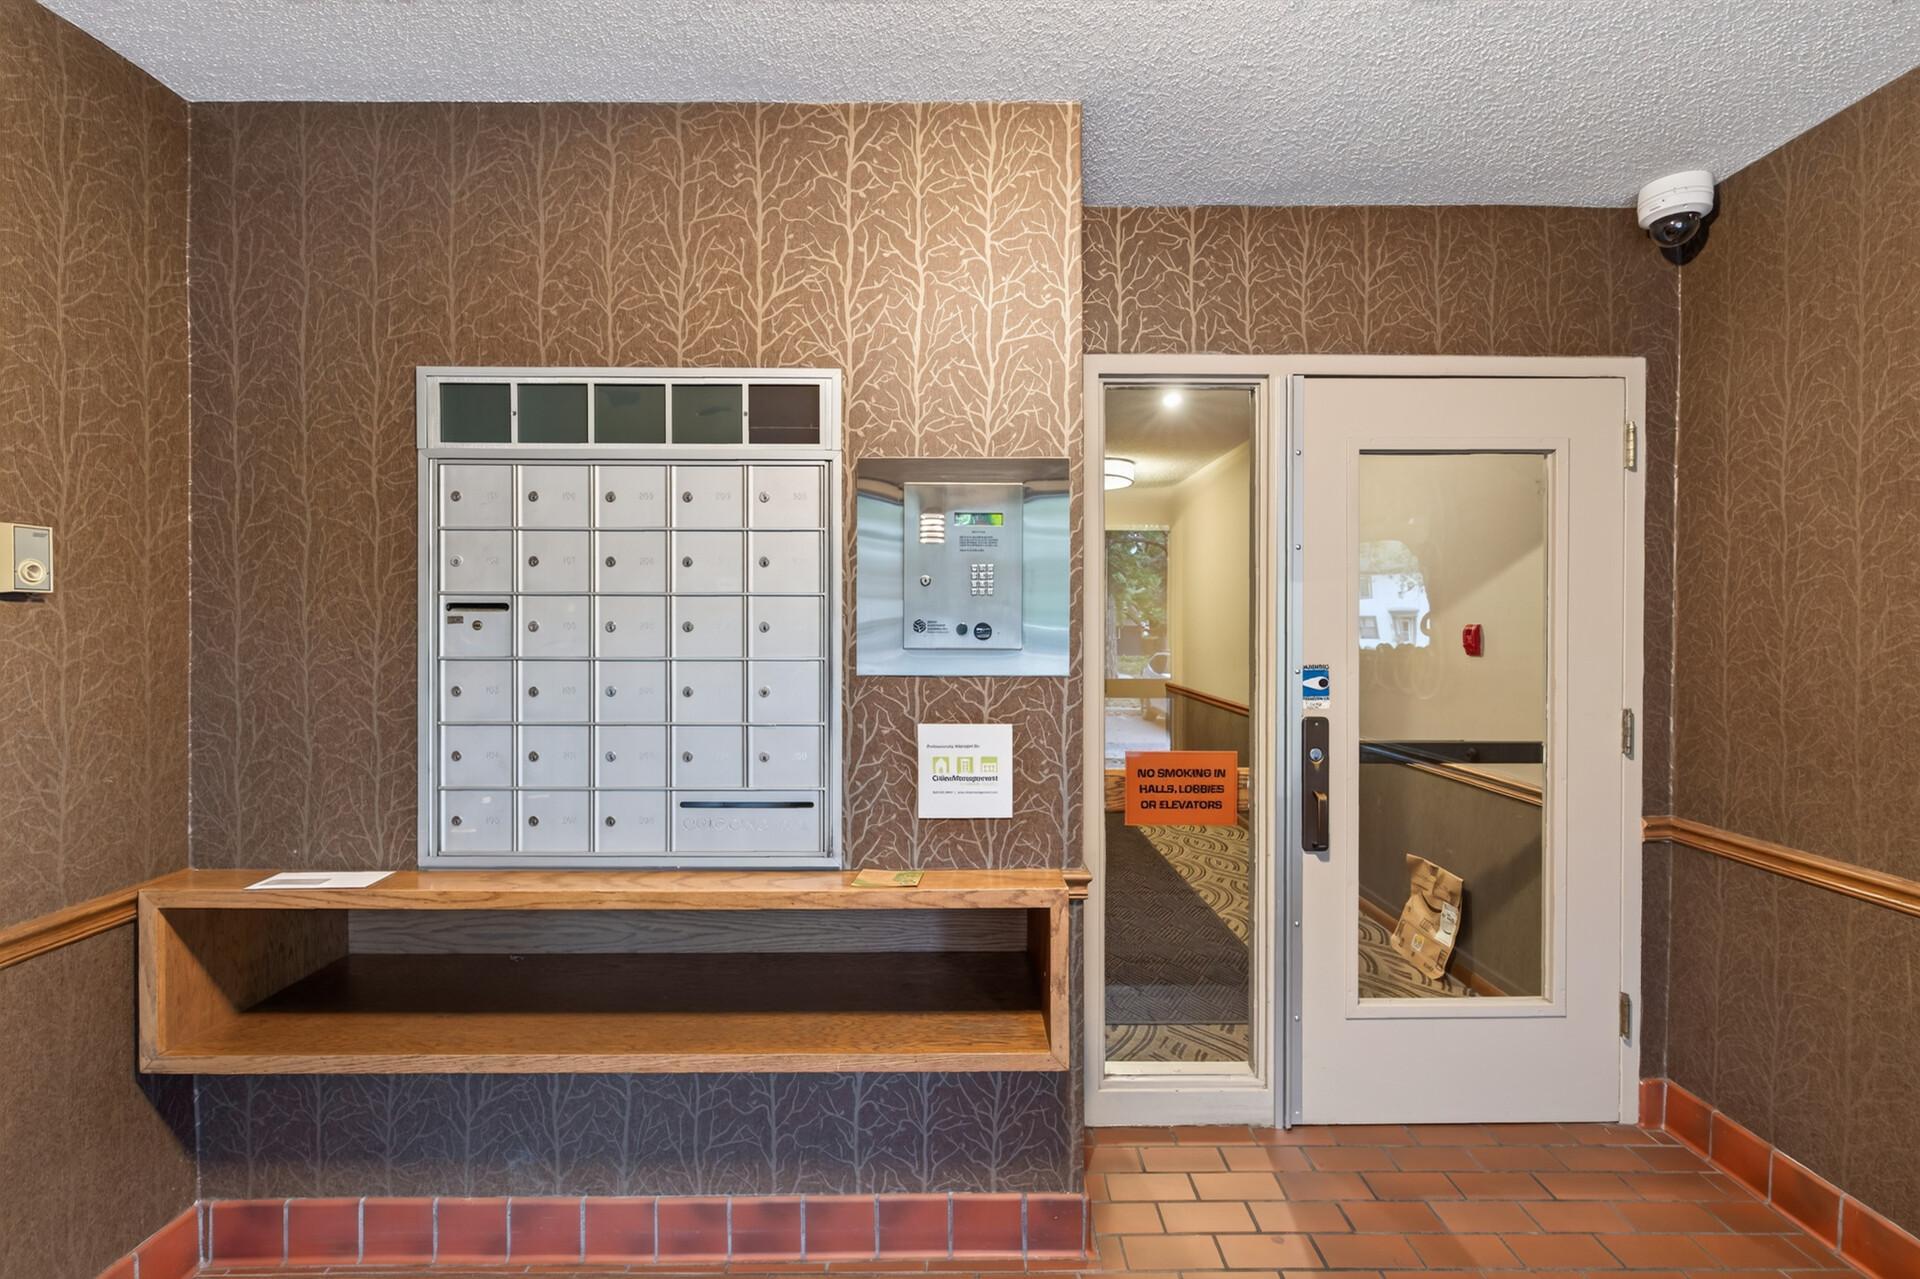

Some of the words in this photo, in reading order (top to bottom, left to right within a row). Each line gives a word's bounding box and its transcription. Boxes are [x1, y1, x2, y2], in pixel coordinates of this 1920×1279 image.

[1137, 768, 1155, 778] NO
[1157, 768, 1211, 778] SMOKING
[1214, 768, 1226, 778] IN
[1179, 784, 1225, 794] LOBBIES
[1140, 800, 1156, 809] OR
[1159, 800, 1222, 809] ELEVATORS
